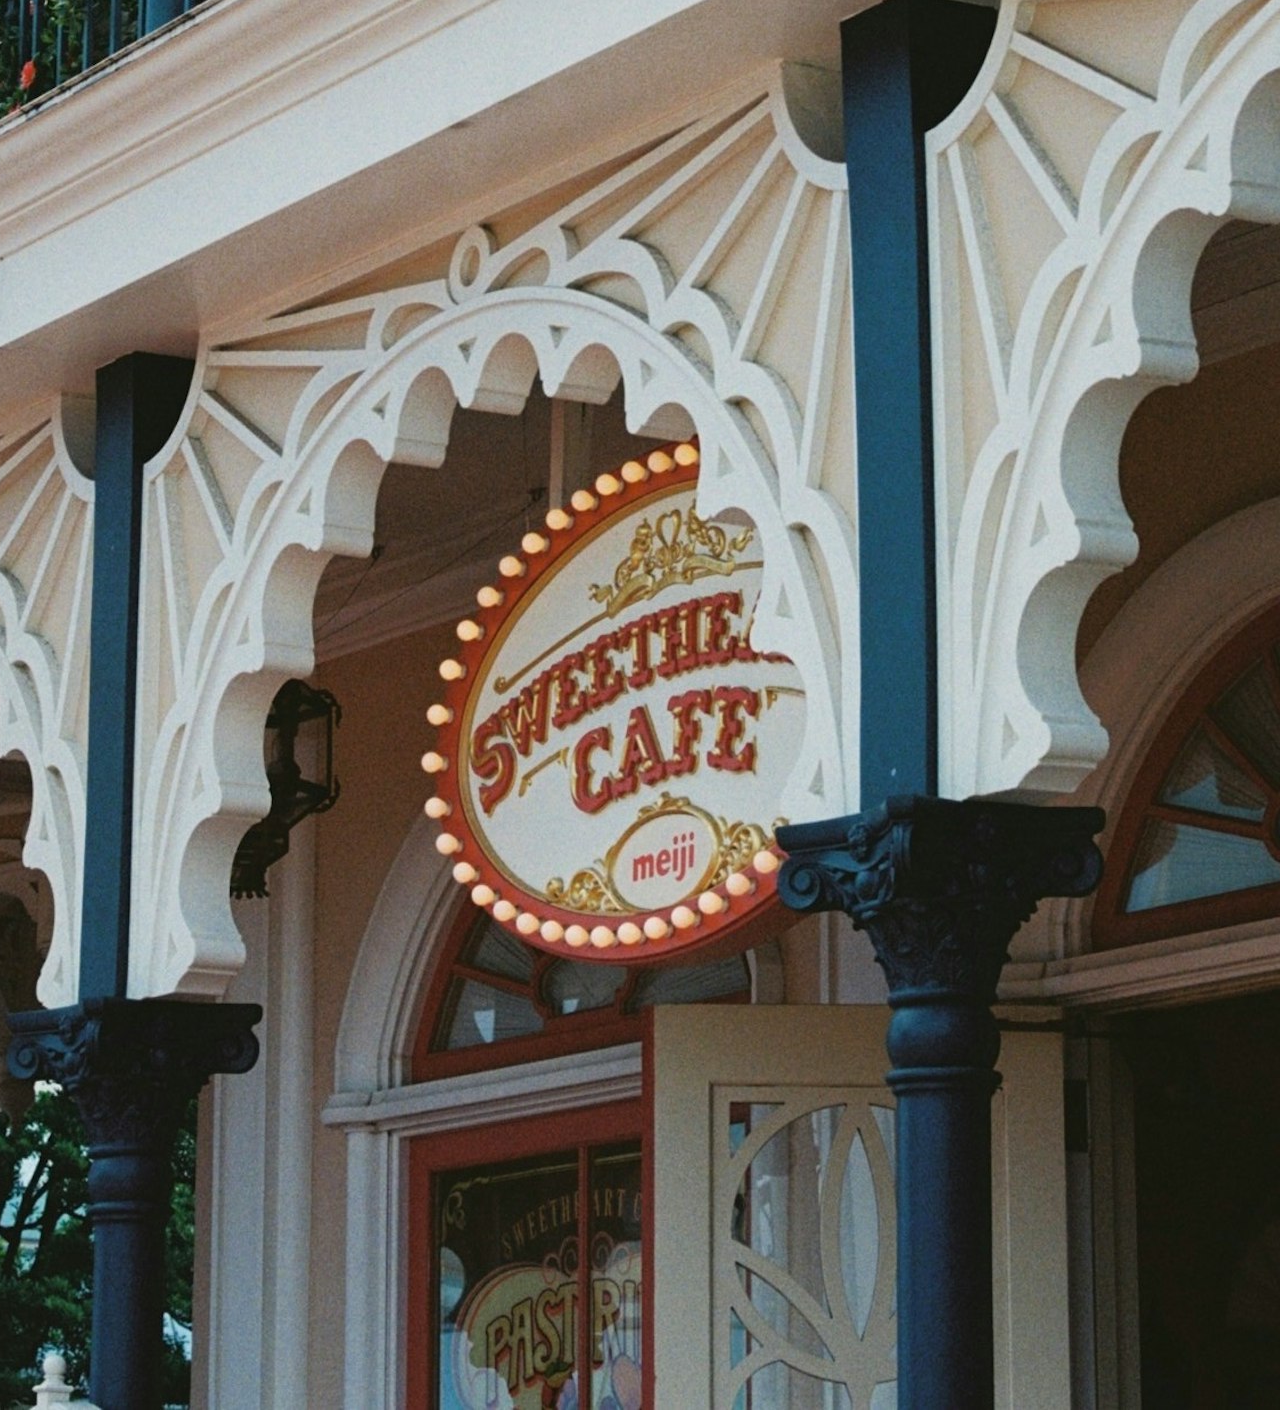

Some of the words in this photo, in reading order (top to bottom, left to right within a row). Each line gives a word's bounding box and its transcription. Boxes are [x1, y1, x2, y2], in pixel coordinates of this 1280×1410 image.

[470, 589, 794, 818] SWEETHE
[570, 685, 763, 815] CAFE
[632, 831, 695, 883] meiji
[485, 1278, 642, 1408] PASTRI
